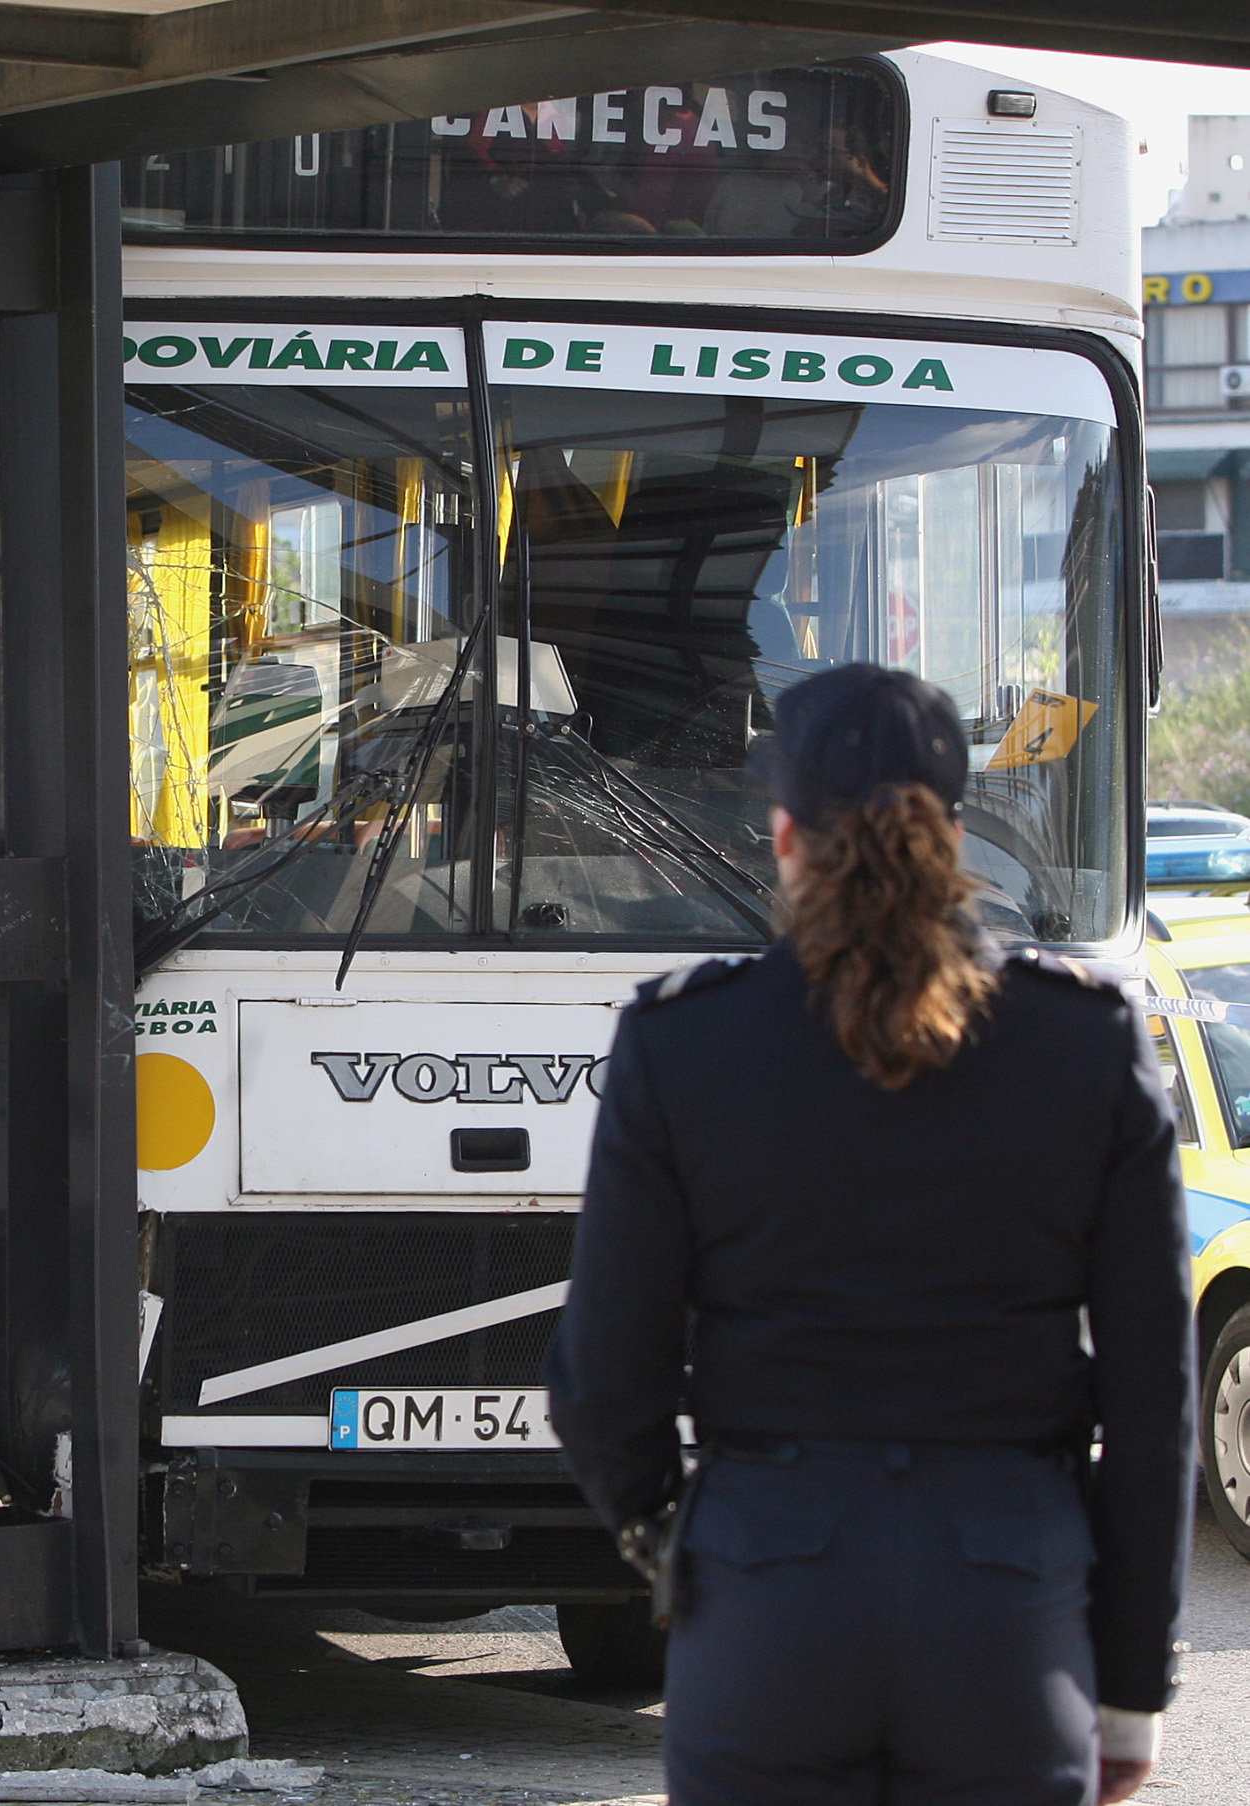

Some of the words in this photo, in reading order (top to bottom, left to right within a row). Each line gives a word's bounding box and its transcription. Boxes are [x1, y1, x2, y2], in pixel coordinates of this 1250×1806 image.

[123, 330, 451, 372] OVIÁRIA
[502, 338, 605, 372] DE
[650, 344, 955, 392] LISBOA
[1023, 727, 1054, 762] 4
[311, 1052, 610, 1104] VOLV
[340, 1425, 351, 1439] P
